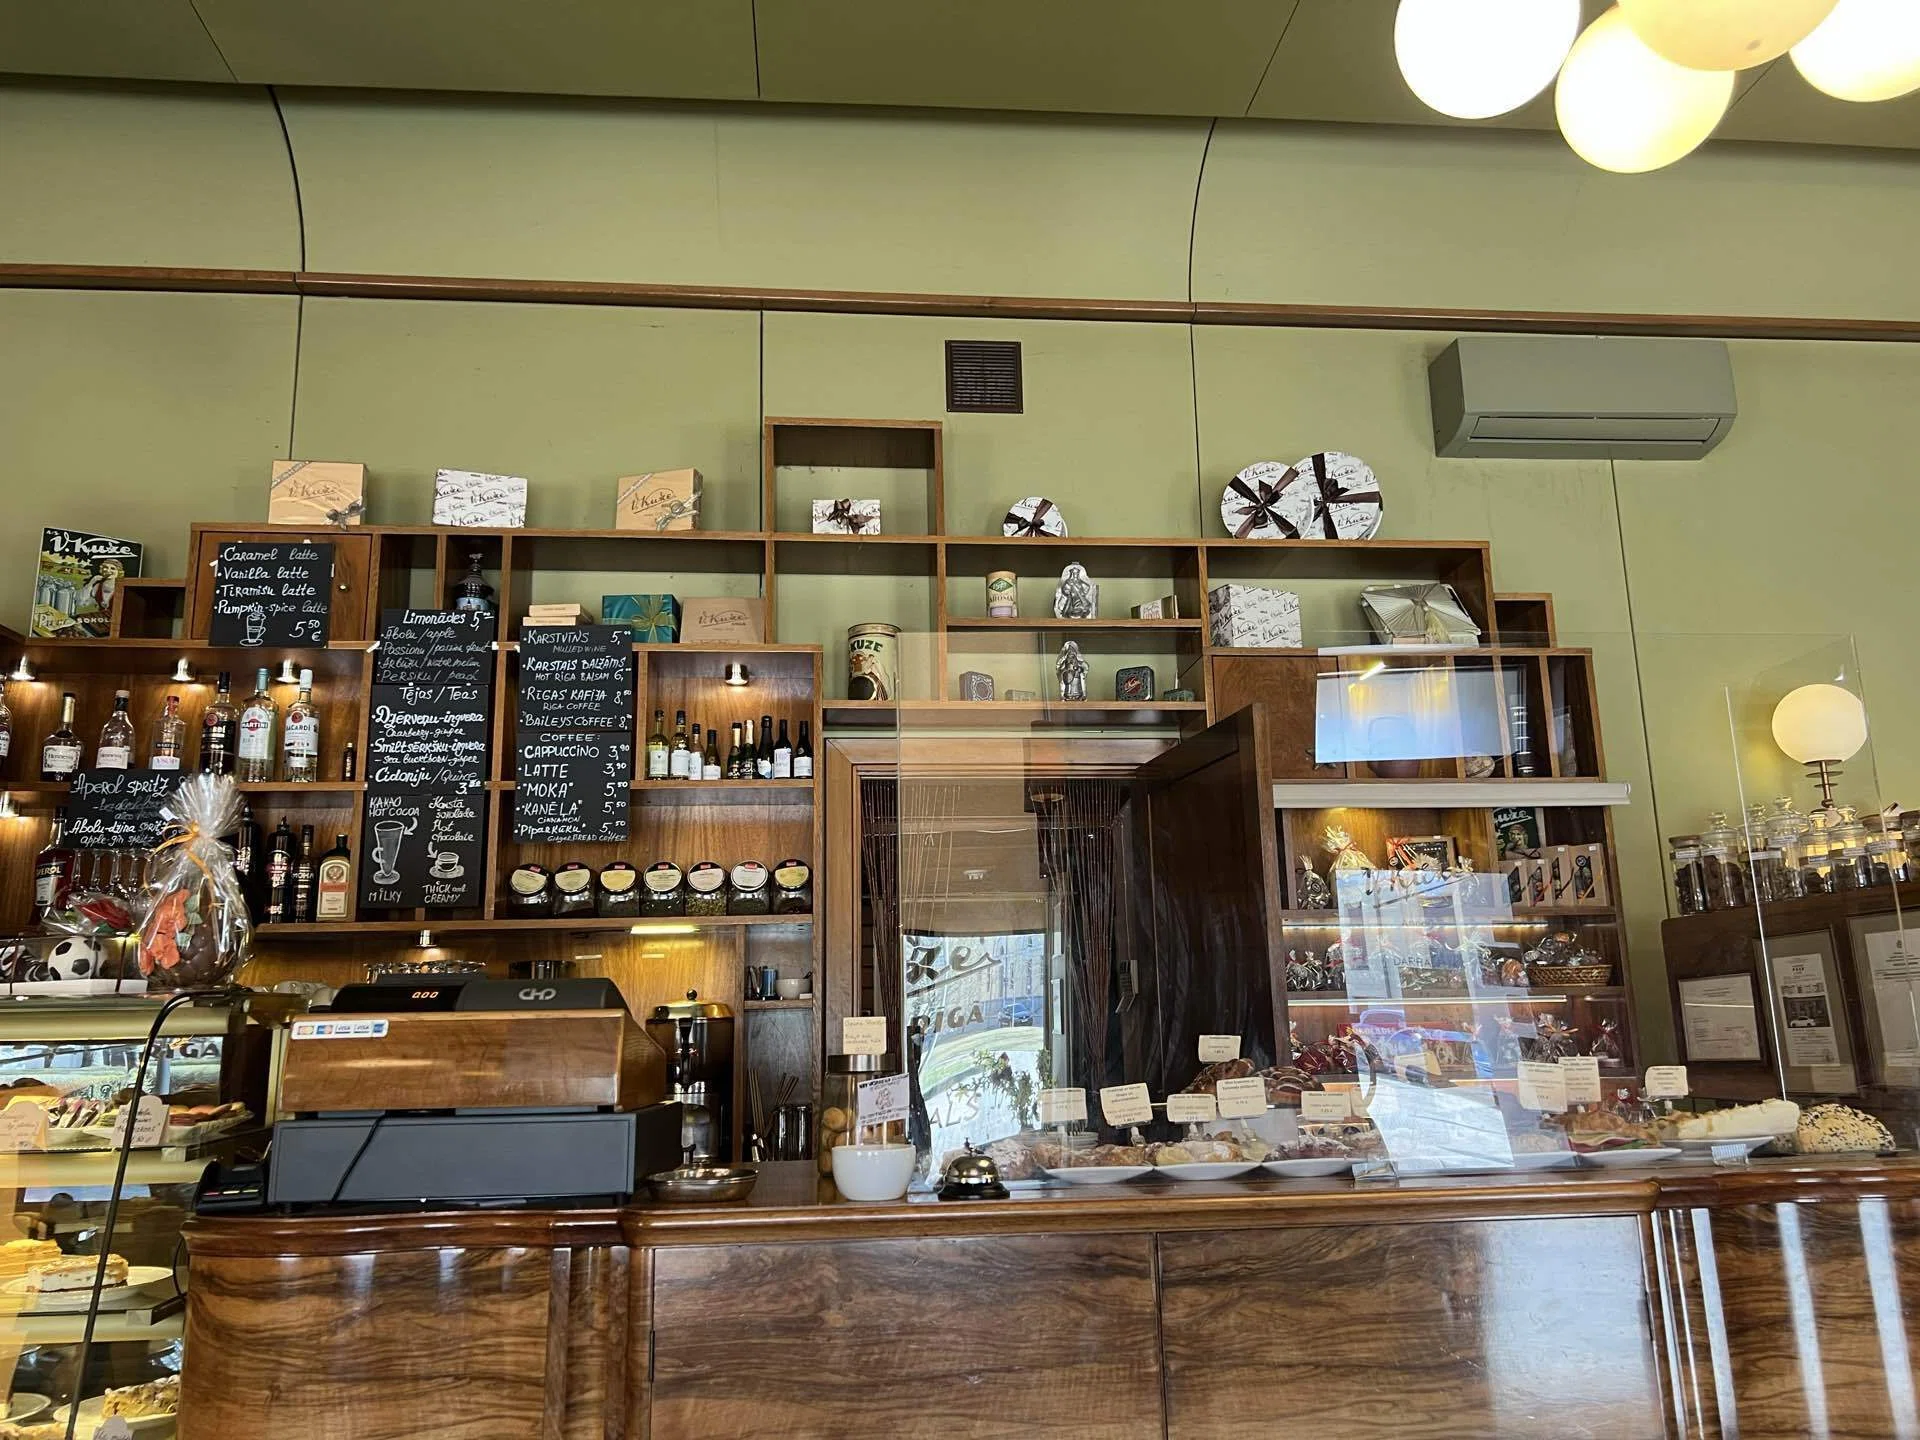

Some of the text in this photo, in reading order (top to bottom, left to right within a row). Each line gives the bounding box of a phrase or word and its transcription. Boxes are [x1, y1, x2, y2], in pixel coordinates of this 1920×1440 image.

[224, 545, 319, 561] Caramel latte
[224, 566, 309, 580] Vanilla latte
[220, 583, 317, 597] Tiramisu latte
[302, 600, 328, 614] latte
[403, 610, 465, 624] Limonādes
[535, 672, 552, 681] HOT
[399, 686, 432, 705] Tējas
[447, 686, 478, 700] Teas
[524, 764, 568, 778] LATTE
[70, 773, 124, 800] Aperol
[370, 796, 401, 809] KAKAO
[369, 807, 419, 817] HOT COCOA
[432, 819, 454, 832] Hot
[424, 894, 460, 903] CREAMY
